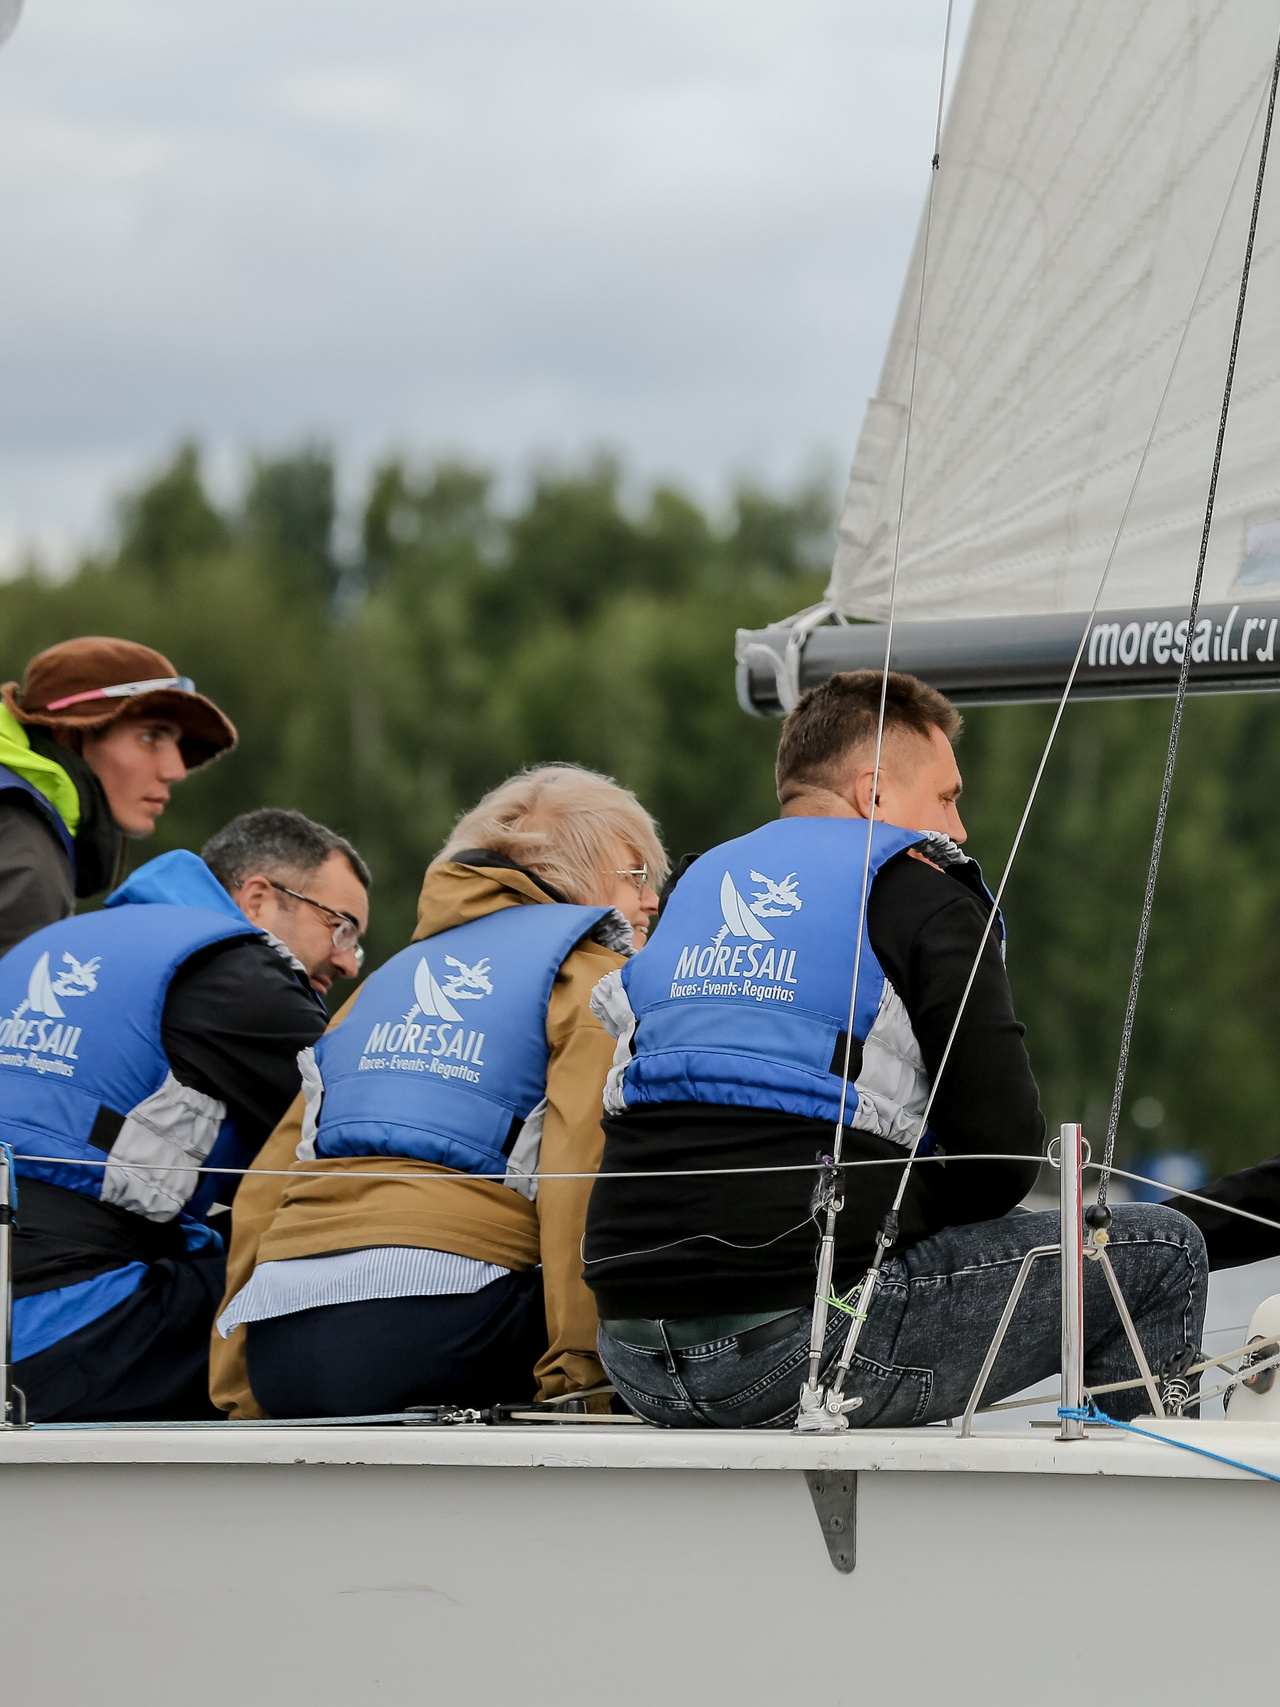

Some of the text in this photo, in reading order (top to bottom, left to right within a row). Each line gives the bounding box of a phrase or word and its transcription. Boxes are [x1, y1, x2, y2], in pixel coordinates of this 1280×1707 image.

[673, 943, 798, 984] MORESAIL
[0, 1017, 82, 1060] ORESAIL
[363, 1021, 485, 1066] MORESAIL
